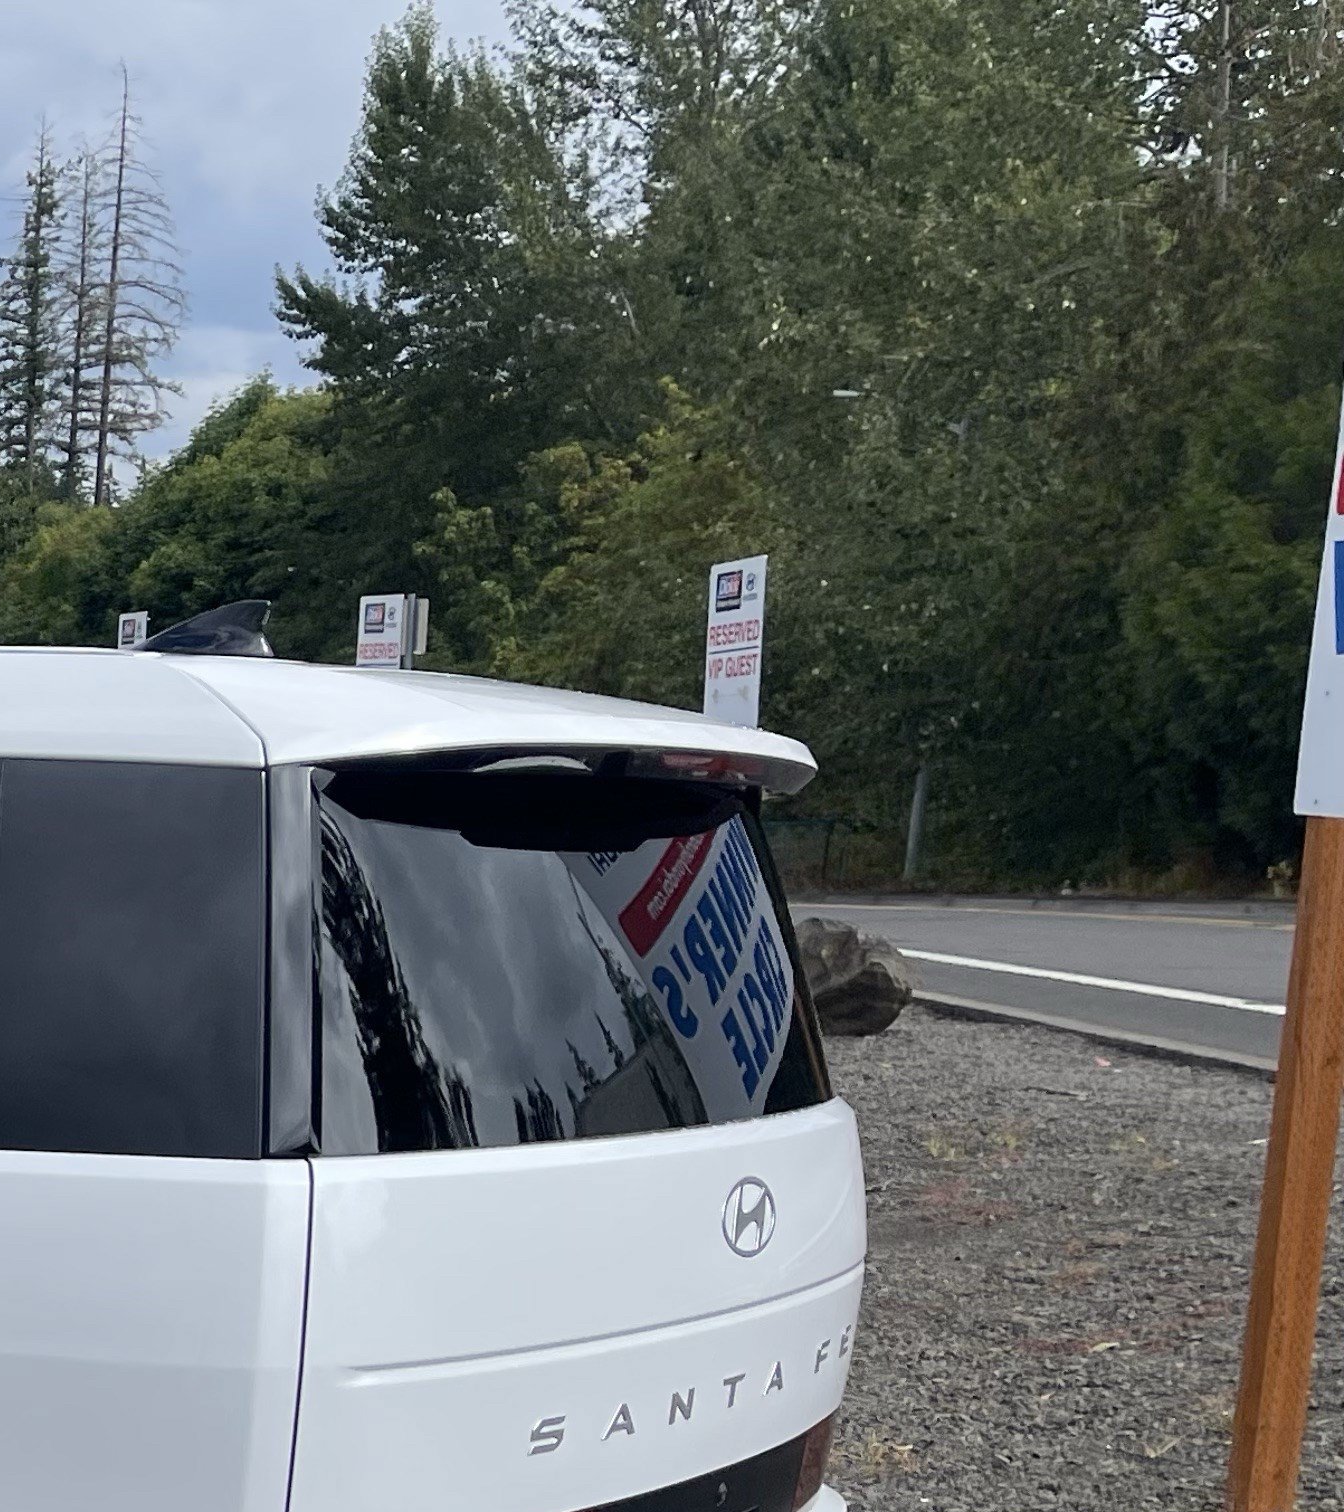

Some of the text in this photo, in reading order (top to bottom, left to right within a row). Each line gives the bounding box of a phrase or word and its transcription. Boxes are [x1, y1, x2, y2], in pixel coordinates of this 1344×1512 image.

[709, 619, 760, 646] RESERVED
[709, 653, 759, 679] VIP GUEST
[526, 1325, 853, 1457] SANTA FE
